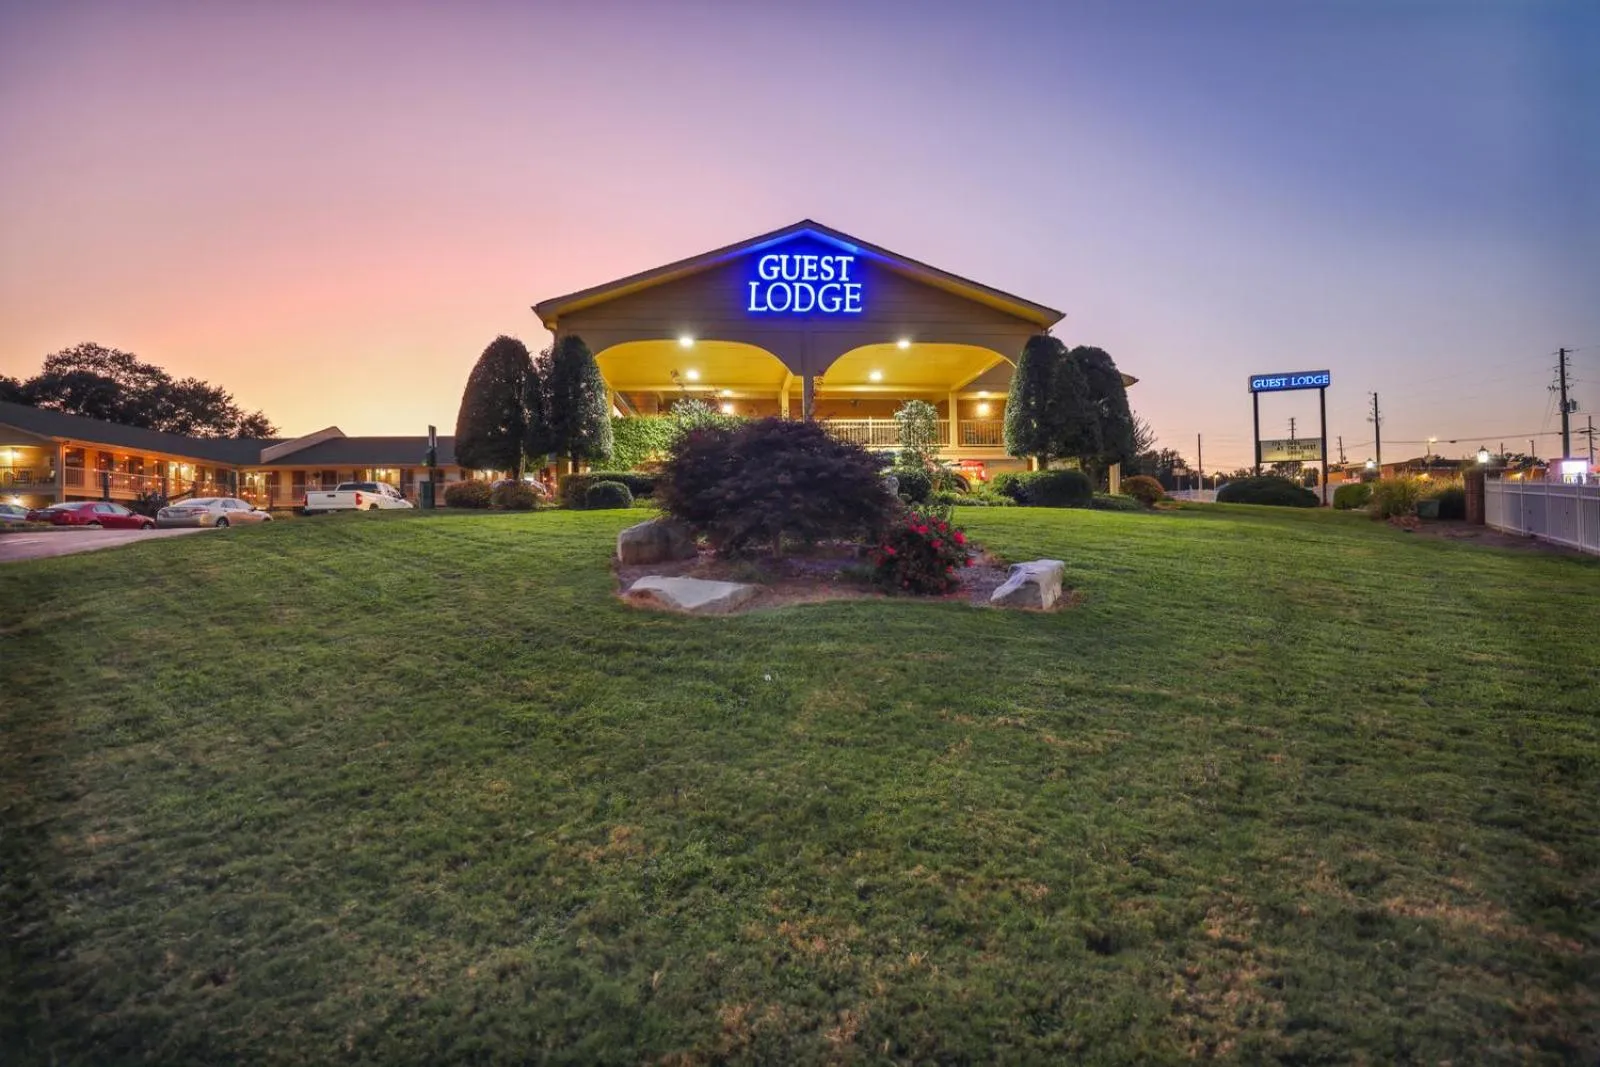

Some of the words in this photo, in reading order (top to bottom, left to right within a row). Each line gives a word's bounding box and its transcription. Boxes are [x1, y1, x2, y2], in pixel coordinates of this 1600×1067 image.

[758, 254, 854, 281] GUEST
[748, 281, 862, 312] LODGE
[1253, 378, 1288, 388] GUEST
[1291, 375, 1328, 386] LODGE
